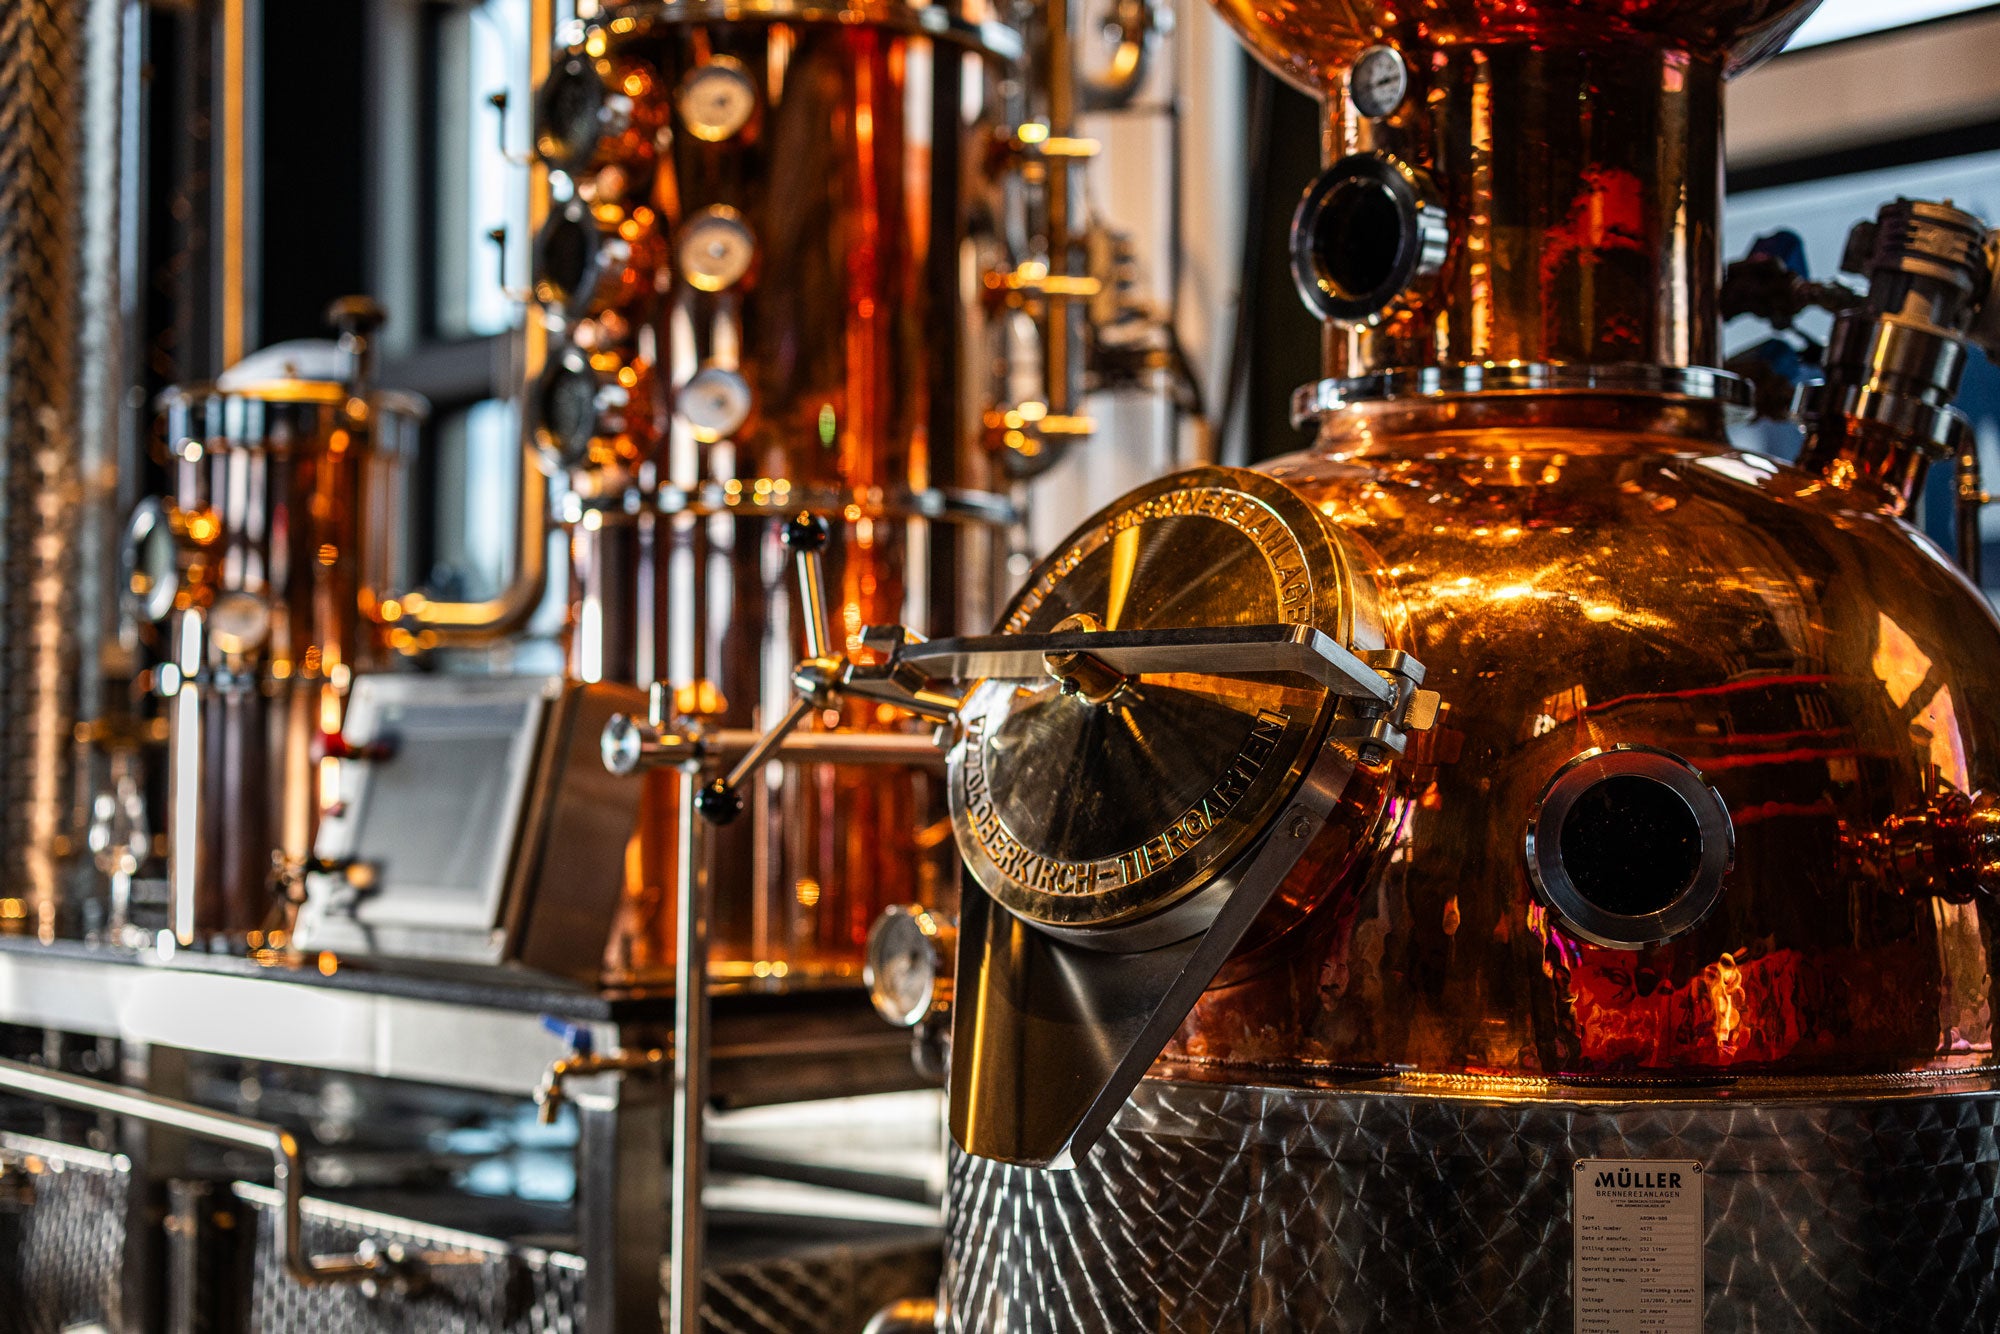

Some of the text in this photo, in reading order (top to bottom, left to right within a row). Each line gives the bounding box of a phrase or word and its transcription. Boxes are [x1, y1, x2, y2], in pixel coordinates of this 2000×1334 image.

[975, 708, 1291, 896] OBERKIRCH-TIERGARTEN
[1598, 1167, 1682, 1188] MÜLLER
[1596, 1190, 1680, 1198] BRENNEREIANLAGEN
